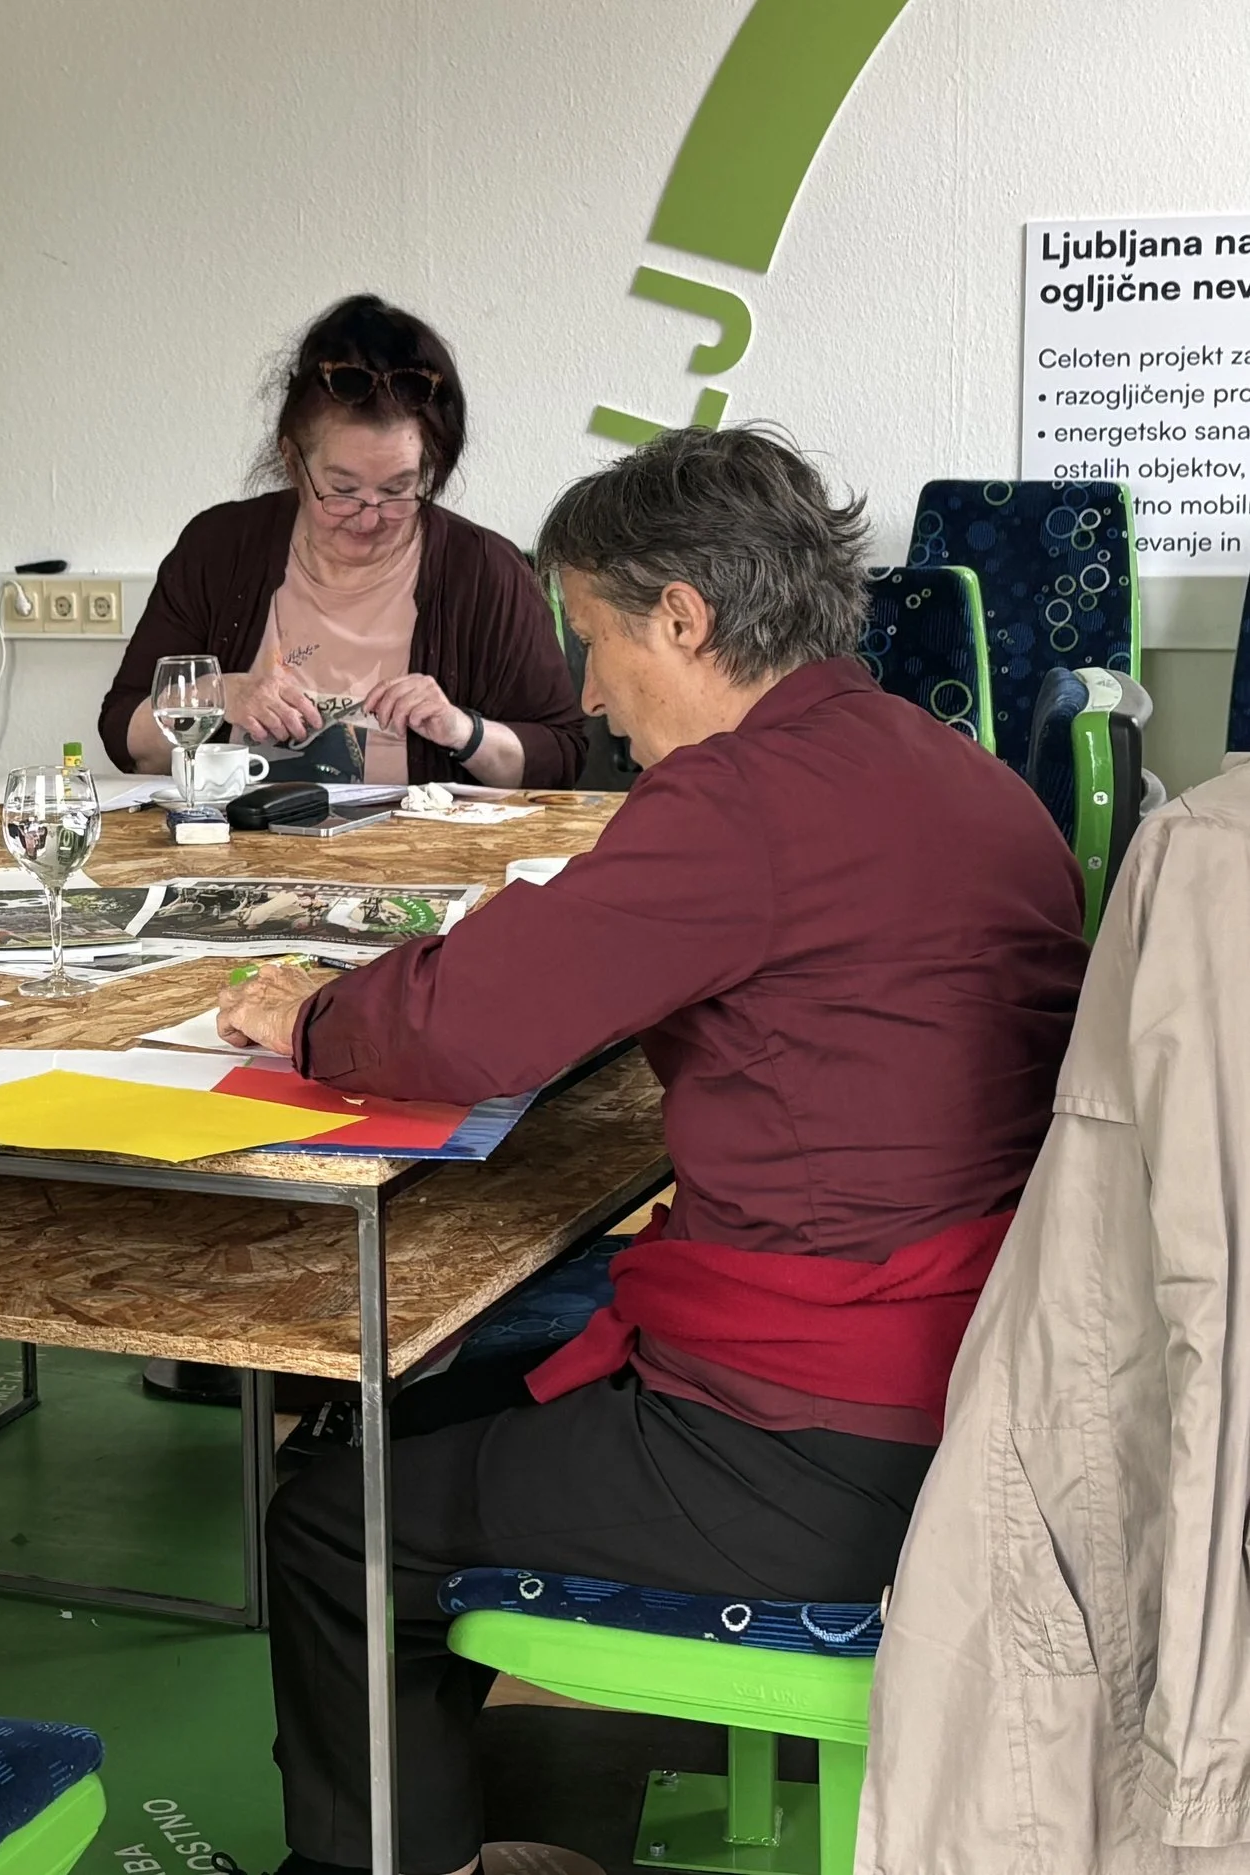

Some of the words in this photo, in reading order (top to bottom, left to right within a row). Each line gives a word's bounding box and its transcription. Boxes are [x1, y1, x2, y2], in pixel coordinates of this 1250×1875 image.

[1042, 229, 1203, 269] Ljubljana
[1040, 273, 1181, 312] ogljične
[1038, 347, 1131, 369] Celoten
[1139, 345, 1224, 372] projekt
[1055, 383, 1205, 410] razogljičenje
[1054, 420, 1187, 448] energetsko
[1053, 457, 1130, 479] ostalih
[1138, 456, 1246, 484] objektov,
[1133, 496, 1172, 515] tno
[1134, 531, 1212, 558] evanje
[1220, 531, 1241, 552] in
